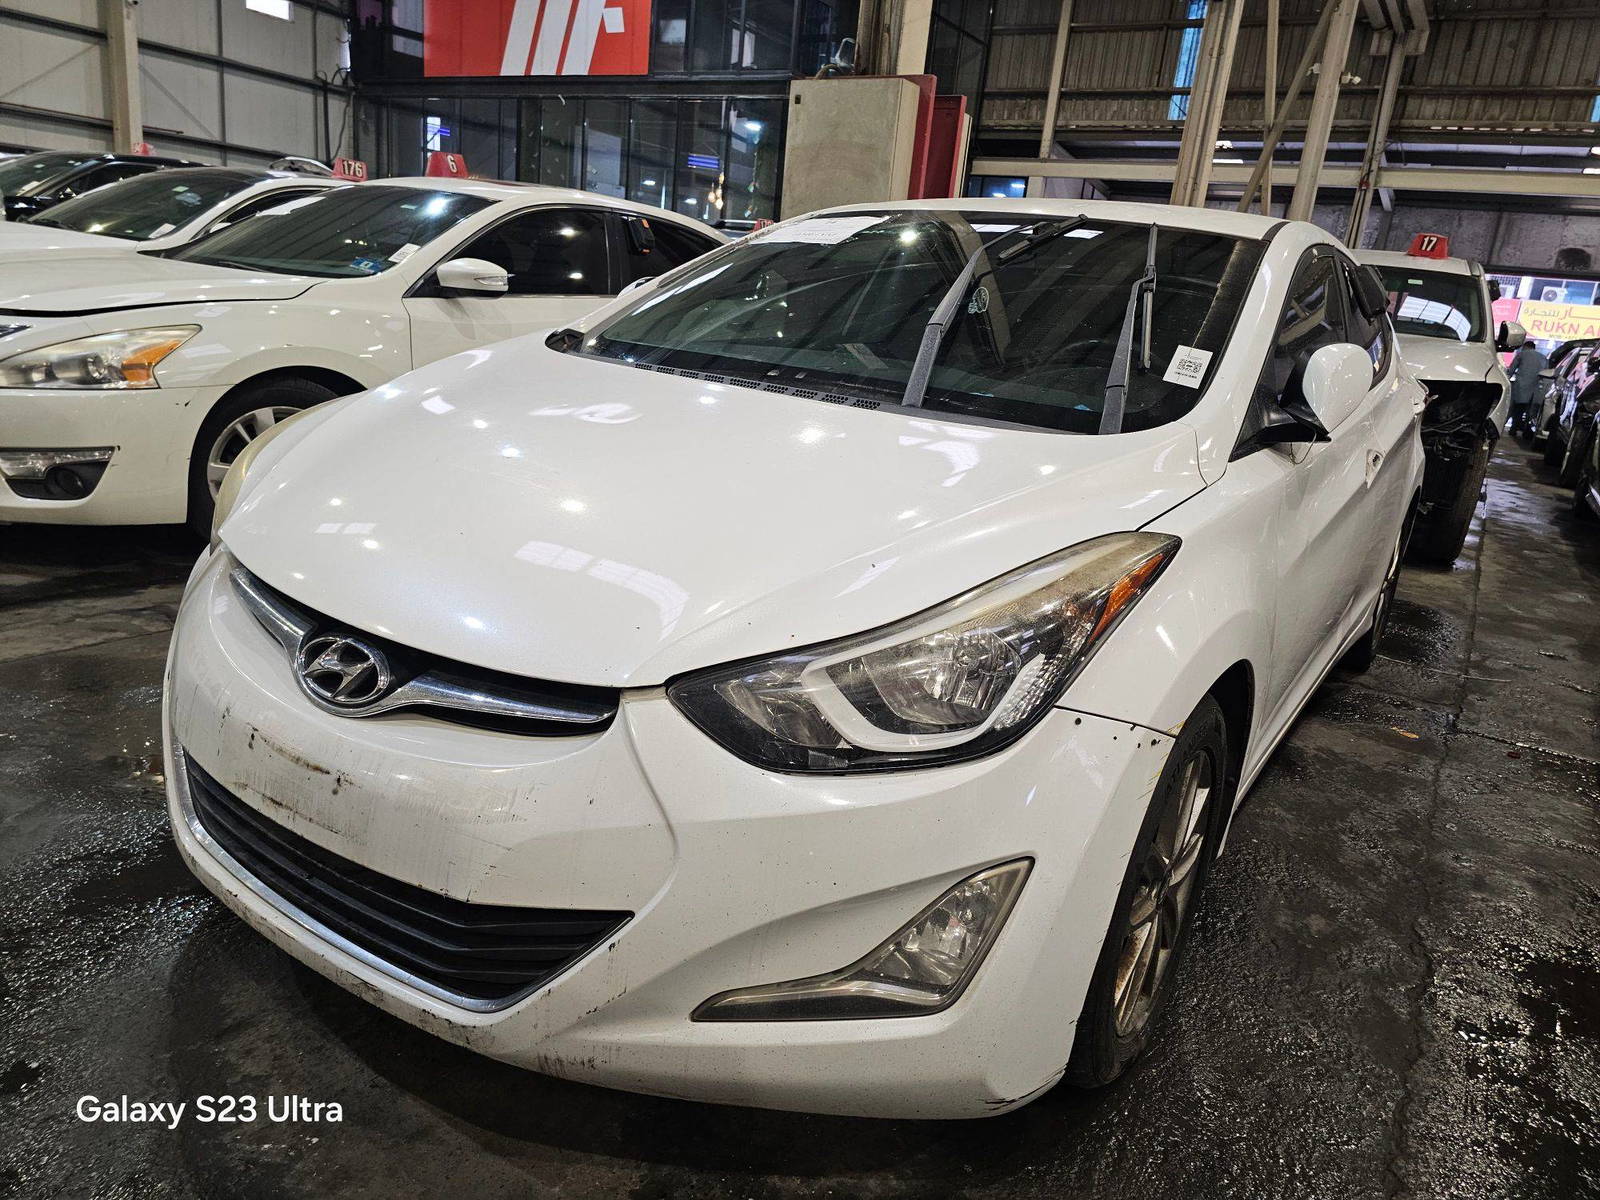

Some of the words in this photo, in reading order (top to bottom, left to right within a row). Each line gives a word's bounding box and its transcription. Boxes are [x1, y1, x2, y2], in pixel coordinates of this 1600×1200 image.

[342, 160, 364, 178] 176
[446, 155, 458, 173] 6
[1421, 236, 1438, 251] 17
[1530, 320, 1580, 335] RUKN
[1583, 325, 1600, 337] A
